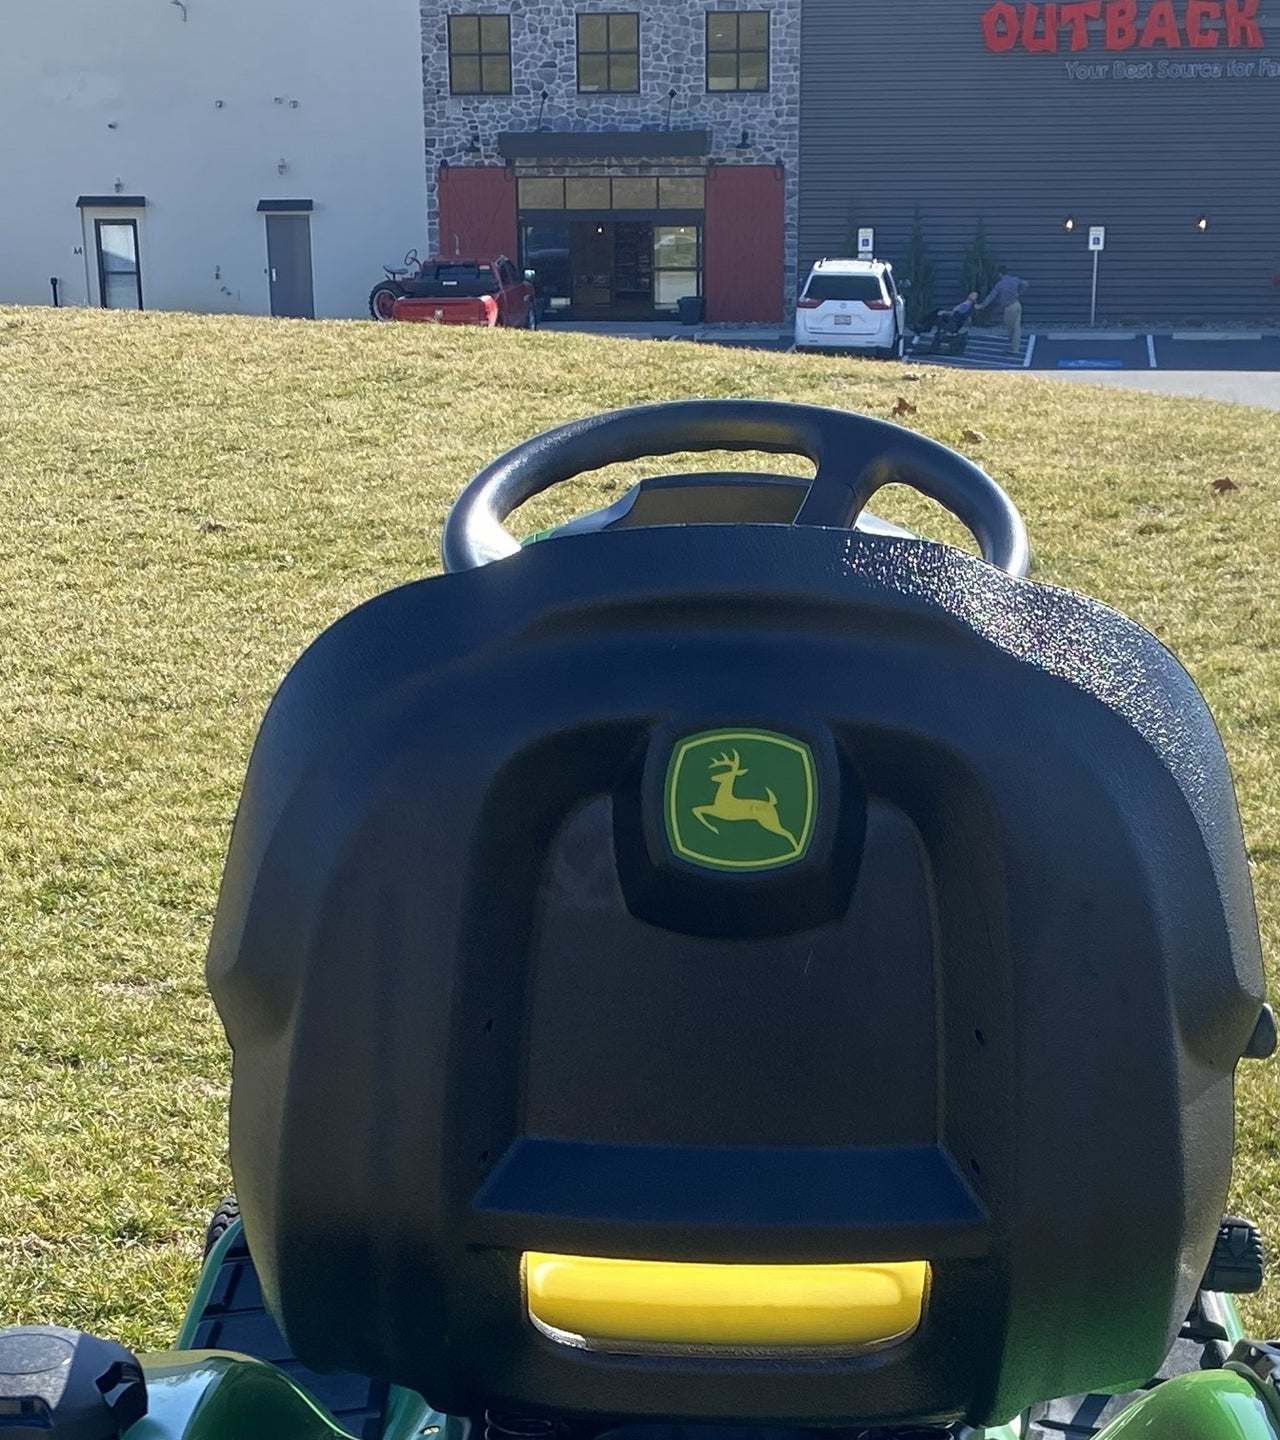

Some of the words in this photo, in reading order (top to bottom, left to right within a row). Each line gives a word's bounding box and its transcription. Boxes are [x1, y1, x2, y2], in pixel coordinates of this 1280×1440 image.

[981, 0, 1264, 53] OUTBACK
[1065, 61, 1111, 80] Your
[1113, 60, 1154, 78] Best
[1157, 59, 1222, 78] Source
[1227, 59, 1255, 77] for
